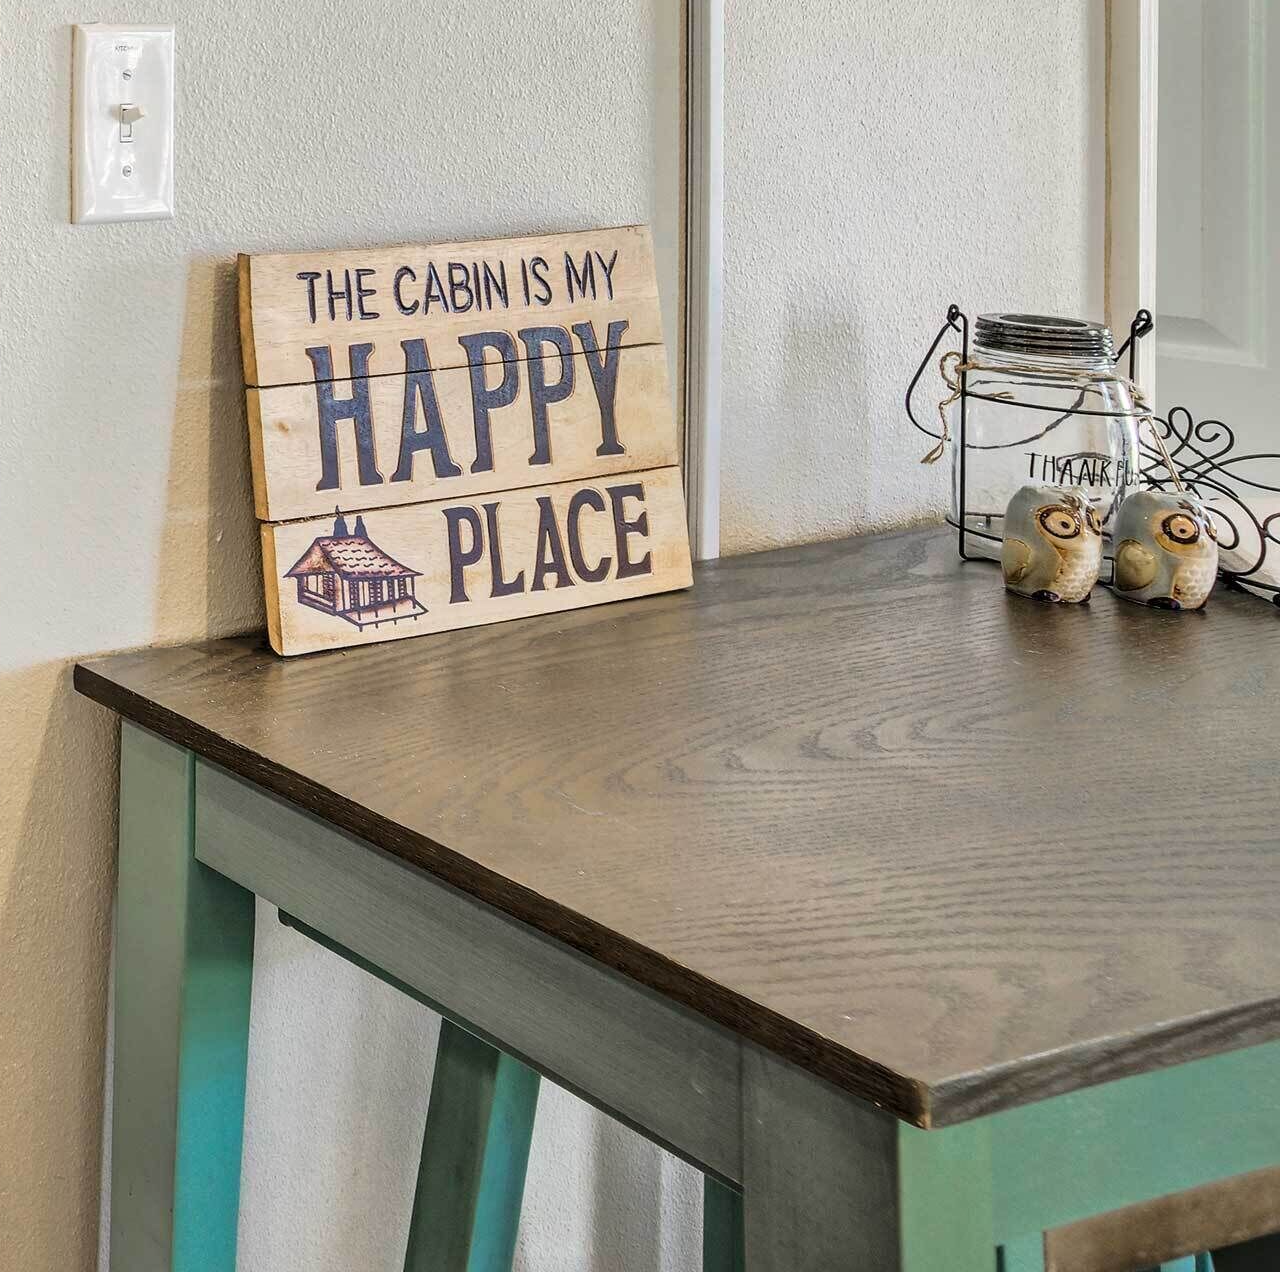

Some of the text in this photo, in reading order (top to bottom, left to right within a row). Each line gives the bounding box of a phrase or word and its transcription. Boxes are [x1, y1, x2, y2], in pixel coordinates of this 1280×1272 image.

[296, 249, 618, 324] THE CABIN IS MY
[304, 320, 629, 492] HAPPY
[1024, 453, 1139, 487] THANKFU
[441, 481, 653, 605] PLACE
